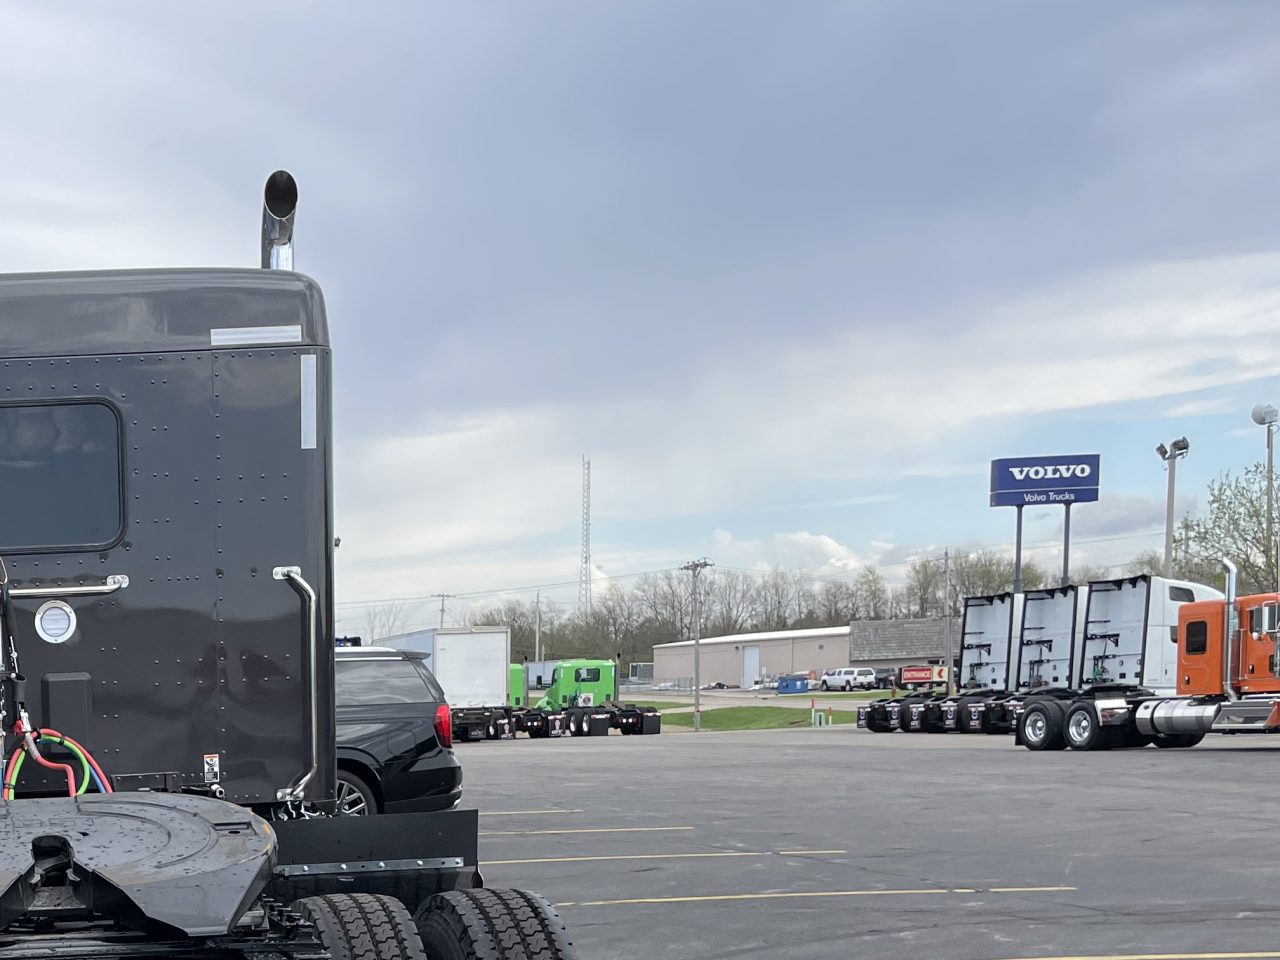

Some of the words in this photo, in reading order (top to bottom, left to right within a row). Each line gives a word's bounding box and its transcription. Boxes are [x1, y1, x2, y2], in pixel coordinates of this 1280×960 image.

[1009, 464, 1091, 480] VOLVO
[1023, 493, 1047, 502] Volvo
[1048, 491, 1076, 501] Trucks
